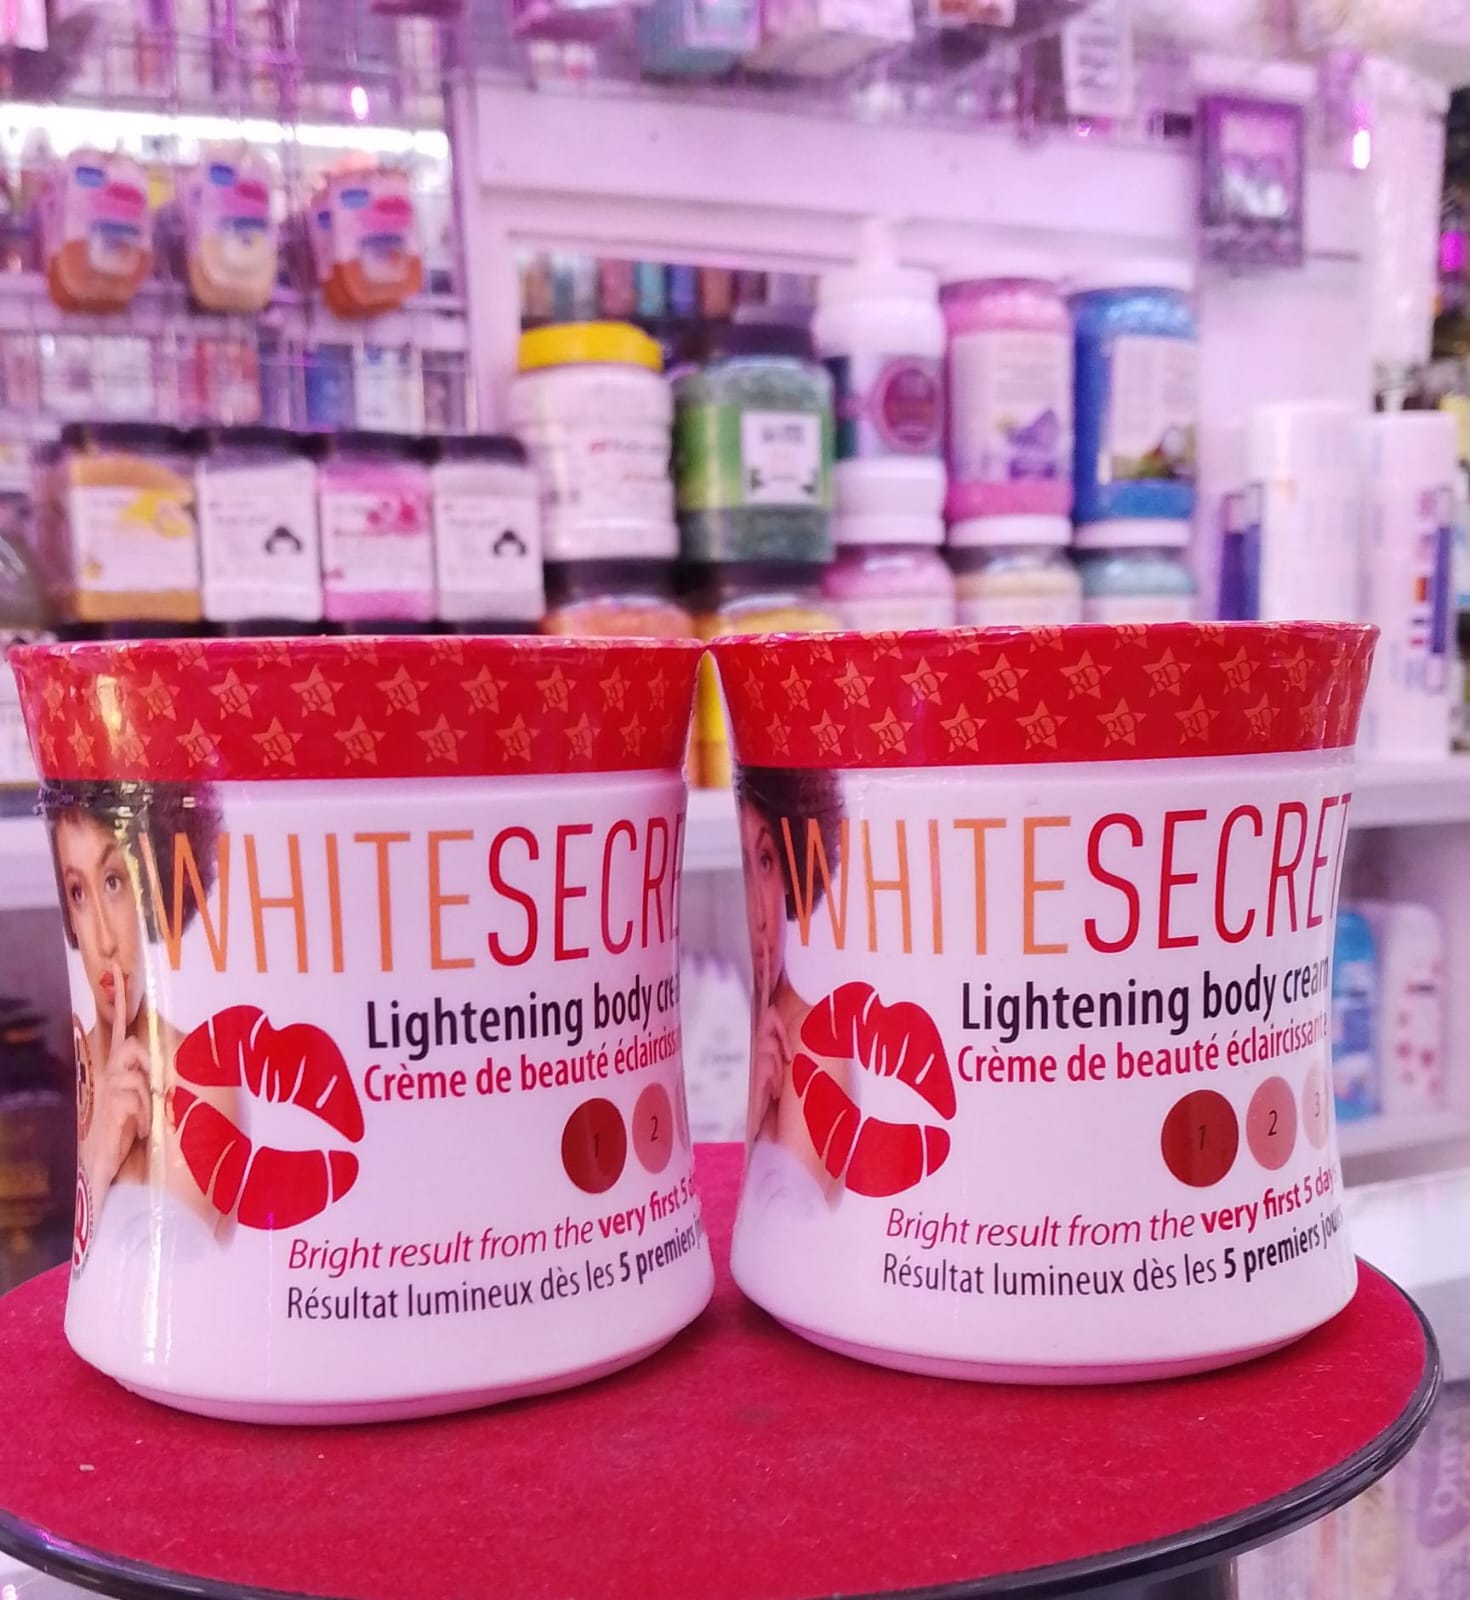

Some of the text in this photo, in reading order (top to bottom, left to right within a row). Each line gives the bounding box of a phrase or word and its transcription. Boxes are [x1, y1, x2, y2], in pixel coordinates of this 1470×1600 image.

[911, 672, 939, 699] RD
[988, 668, 1018, 695] RD
[1071, 666, 1101, 692] RD
[1153, 662, 1181, 688] RD
[1227, 661, 1252, 687] RD
[220, 684, 249, 711] RD
[302, 681, 333, 709] RD
[387, 680, 418, 707] RD
[471, 679, 498, 705] RD
[842, 676, 867, 702] RD
[817, 722, 839, 748] RD
[879, 720, 905, 746] RD
[950, 718, 978, 744] RD
[1027, 715, 1058, 741] RD
[1107, 712, 1137, 739] RD
[1184, 710, 1211, 736] RD
[263, 732, 293, 758] RD
[344, 729, 375, 757] RD
[427, 728, 457, 755] RD
[506, 728, 531, 754] RD
[962, 978, 1189, 1044] Lightening
[1203, 963, 1277, 1023] body
[367, 991, 584, 1061] Lightening
[593, 974, 652, 1032] body
[363, 1025, 681, 1101] Crème de beauté éclairciss
[958, 1045, 1057, 1083] Crème
[1067, 1043, 1106, 1082] de
[1117, 1032, 1219, 1079] beauté
[1197, 1092, 1321, 1151] 1 2 3
[593, 1115, 659, 1158] 1 2
[886, 1165, 1336, 1249] Bright result from the very first 5 day
[288, 1237, 383, 1278] Bright
[388, 1231, 474, 1268] result
[479, 1228, 547, 1260] from
[554, 1216, 594, 1249] the
[598, 1204, 646, 1239] very
[649, 1185, 680, 1222] first
[681, 1177, 688, 1205] 5
[287, 1286, 399, 1320] Résultat
[407, 1280, 534, 1317] lumineux
[540, 1266, 581, 1301] dès
[585, 1260, 615, 1292] les
[619, 1250, 631, 1282] 5
[635, 1225, 695, 1285] premiers
[883, 1253, 984, 1295] Résultat
[994, 1262, 1125, 1296] lumineux
[1133, 1258, 1177, 1292] dès
[1184, 1253, 1217, 1286] les
[1223, 1247, 1237, 1279] 5
[1244, 1223, 1321, 1283] premiers
